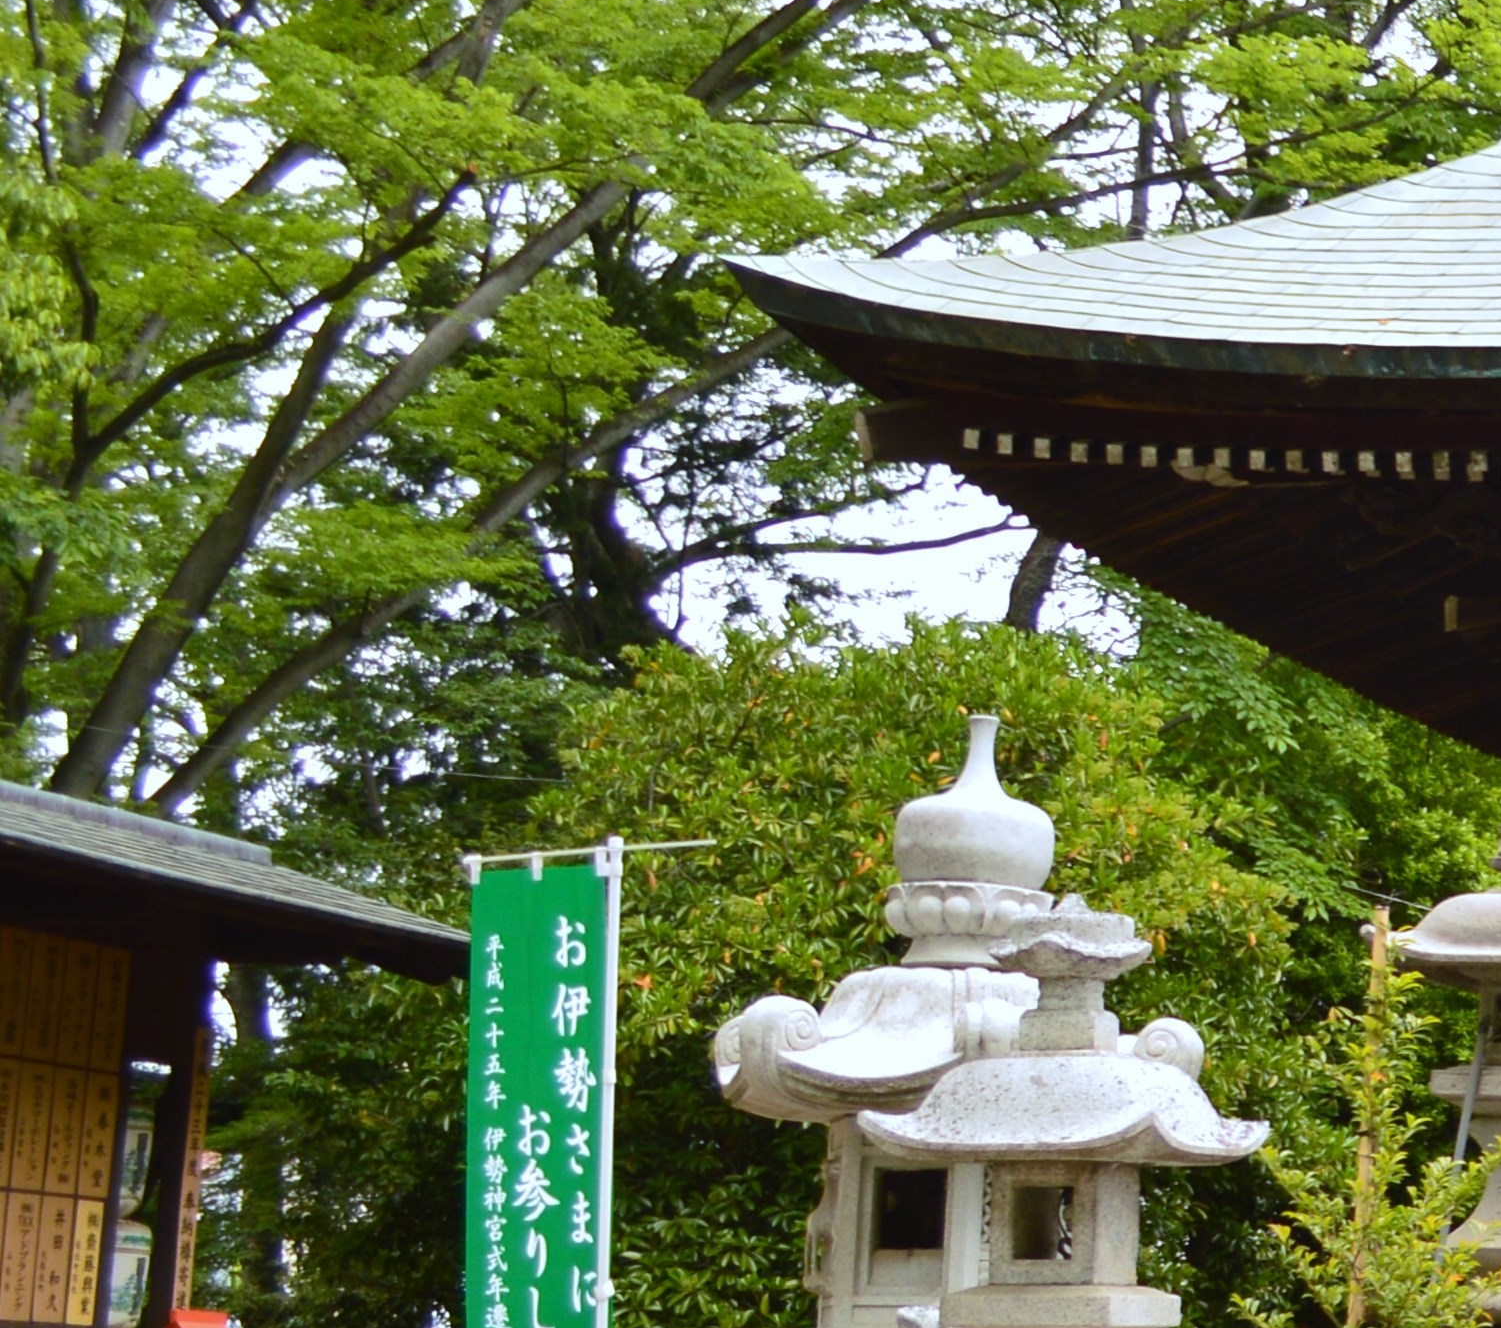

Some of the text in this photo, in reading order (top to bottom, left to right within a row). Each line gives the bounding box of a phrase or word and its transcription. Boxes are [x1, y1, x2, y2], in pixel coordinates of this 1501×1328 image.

[484, 934, 506, 1110] 平成二十五年
[551, 915, 598, 1313] お伊勢さまに
